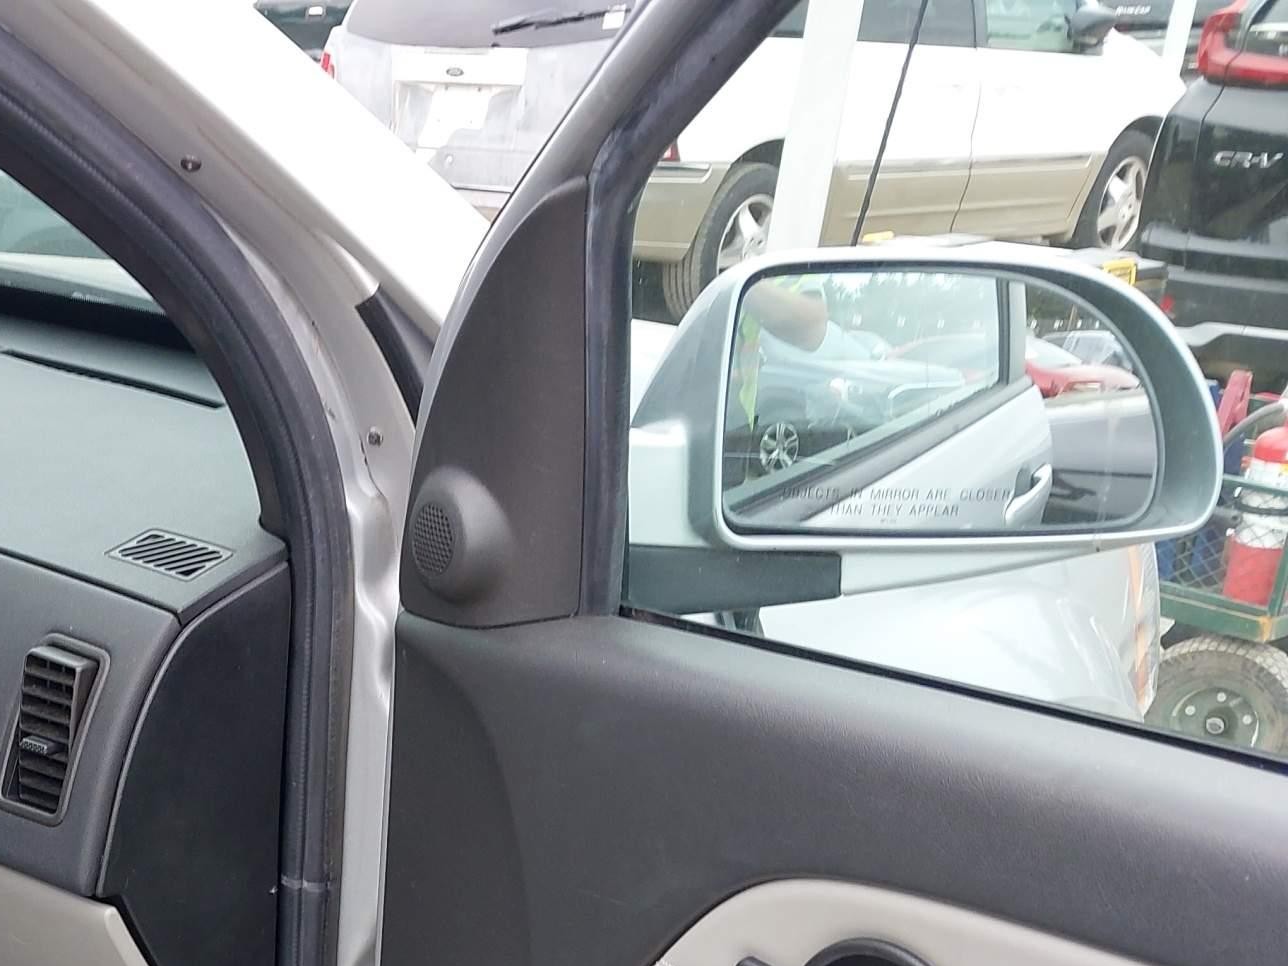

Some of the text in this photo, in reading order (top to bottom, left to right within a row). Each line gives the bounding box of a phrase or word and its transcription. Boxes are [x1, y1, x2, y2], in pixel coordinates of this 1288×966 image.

[1214, 150, 1284, 169] CR-V
[870, 487, 920, 500] MIRROR
[925, 487, 950, 500] ARE
[830, 503, 863, 516] THAN
[871, 503, 903, 517] THEY
